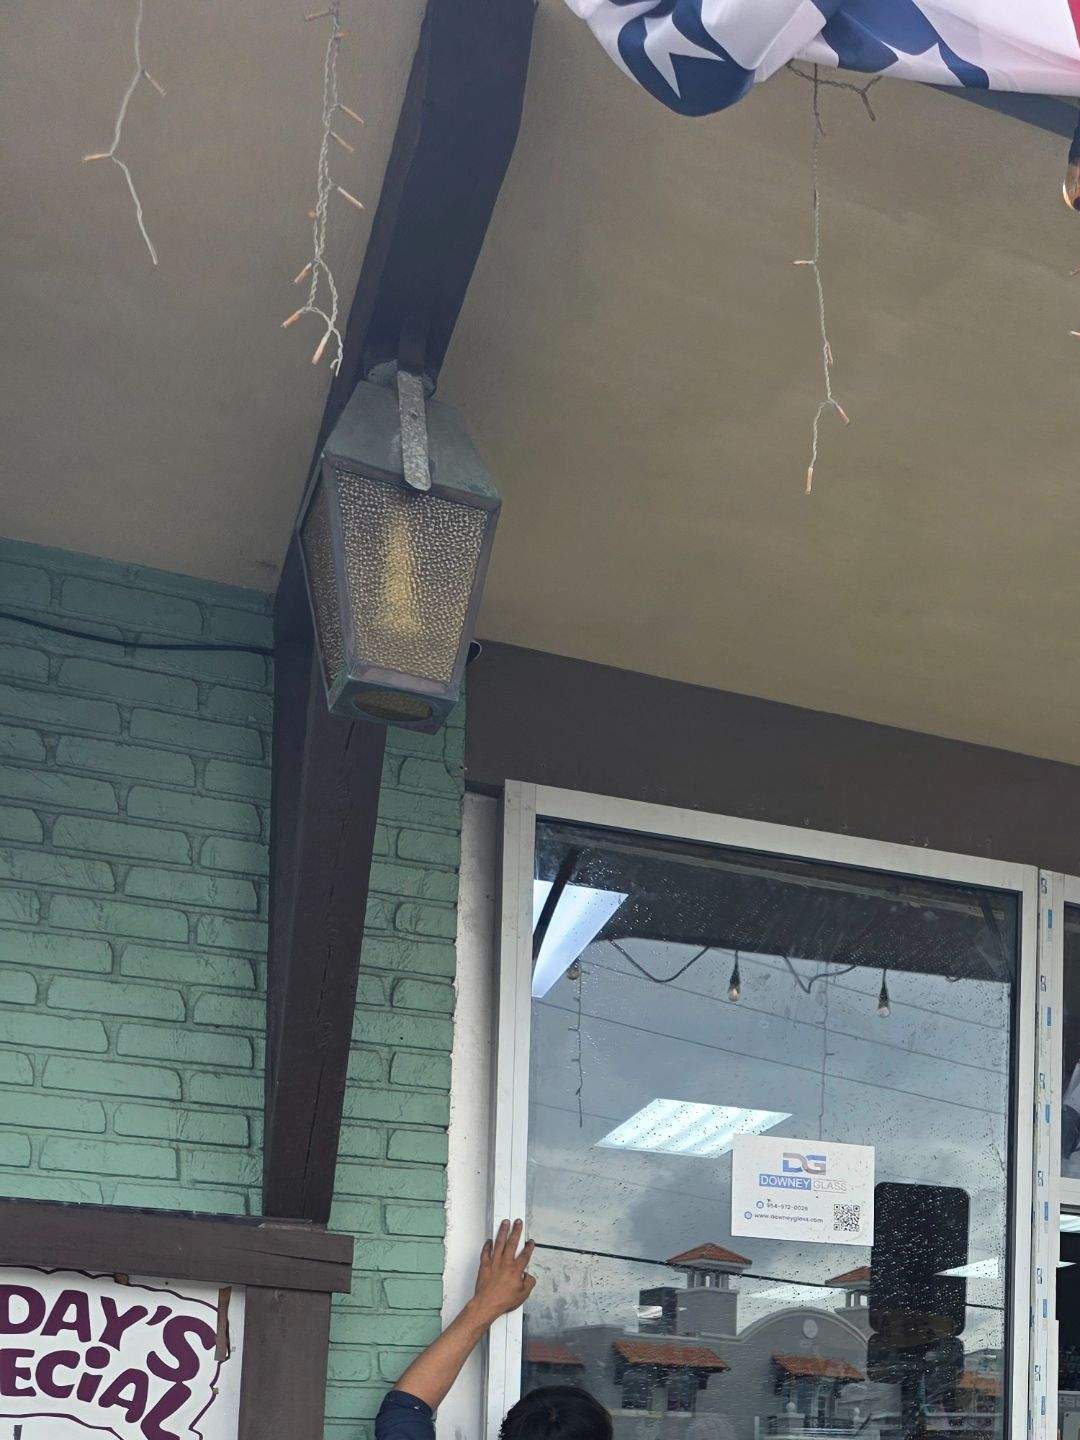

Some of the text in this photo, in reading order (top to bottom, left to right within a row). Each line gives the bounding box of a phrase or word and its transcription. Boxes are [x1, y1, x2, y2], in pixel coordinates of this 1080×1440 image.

[782, 1152, 827, 1176] DG
[759, 1174, 848, 1192] DOWNEY GLASS
